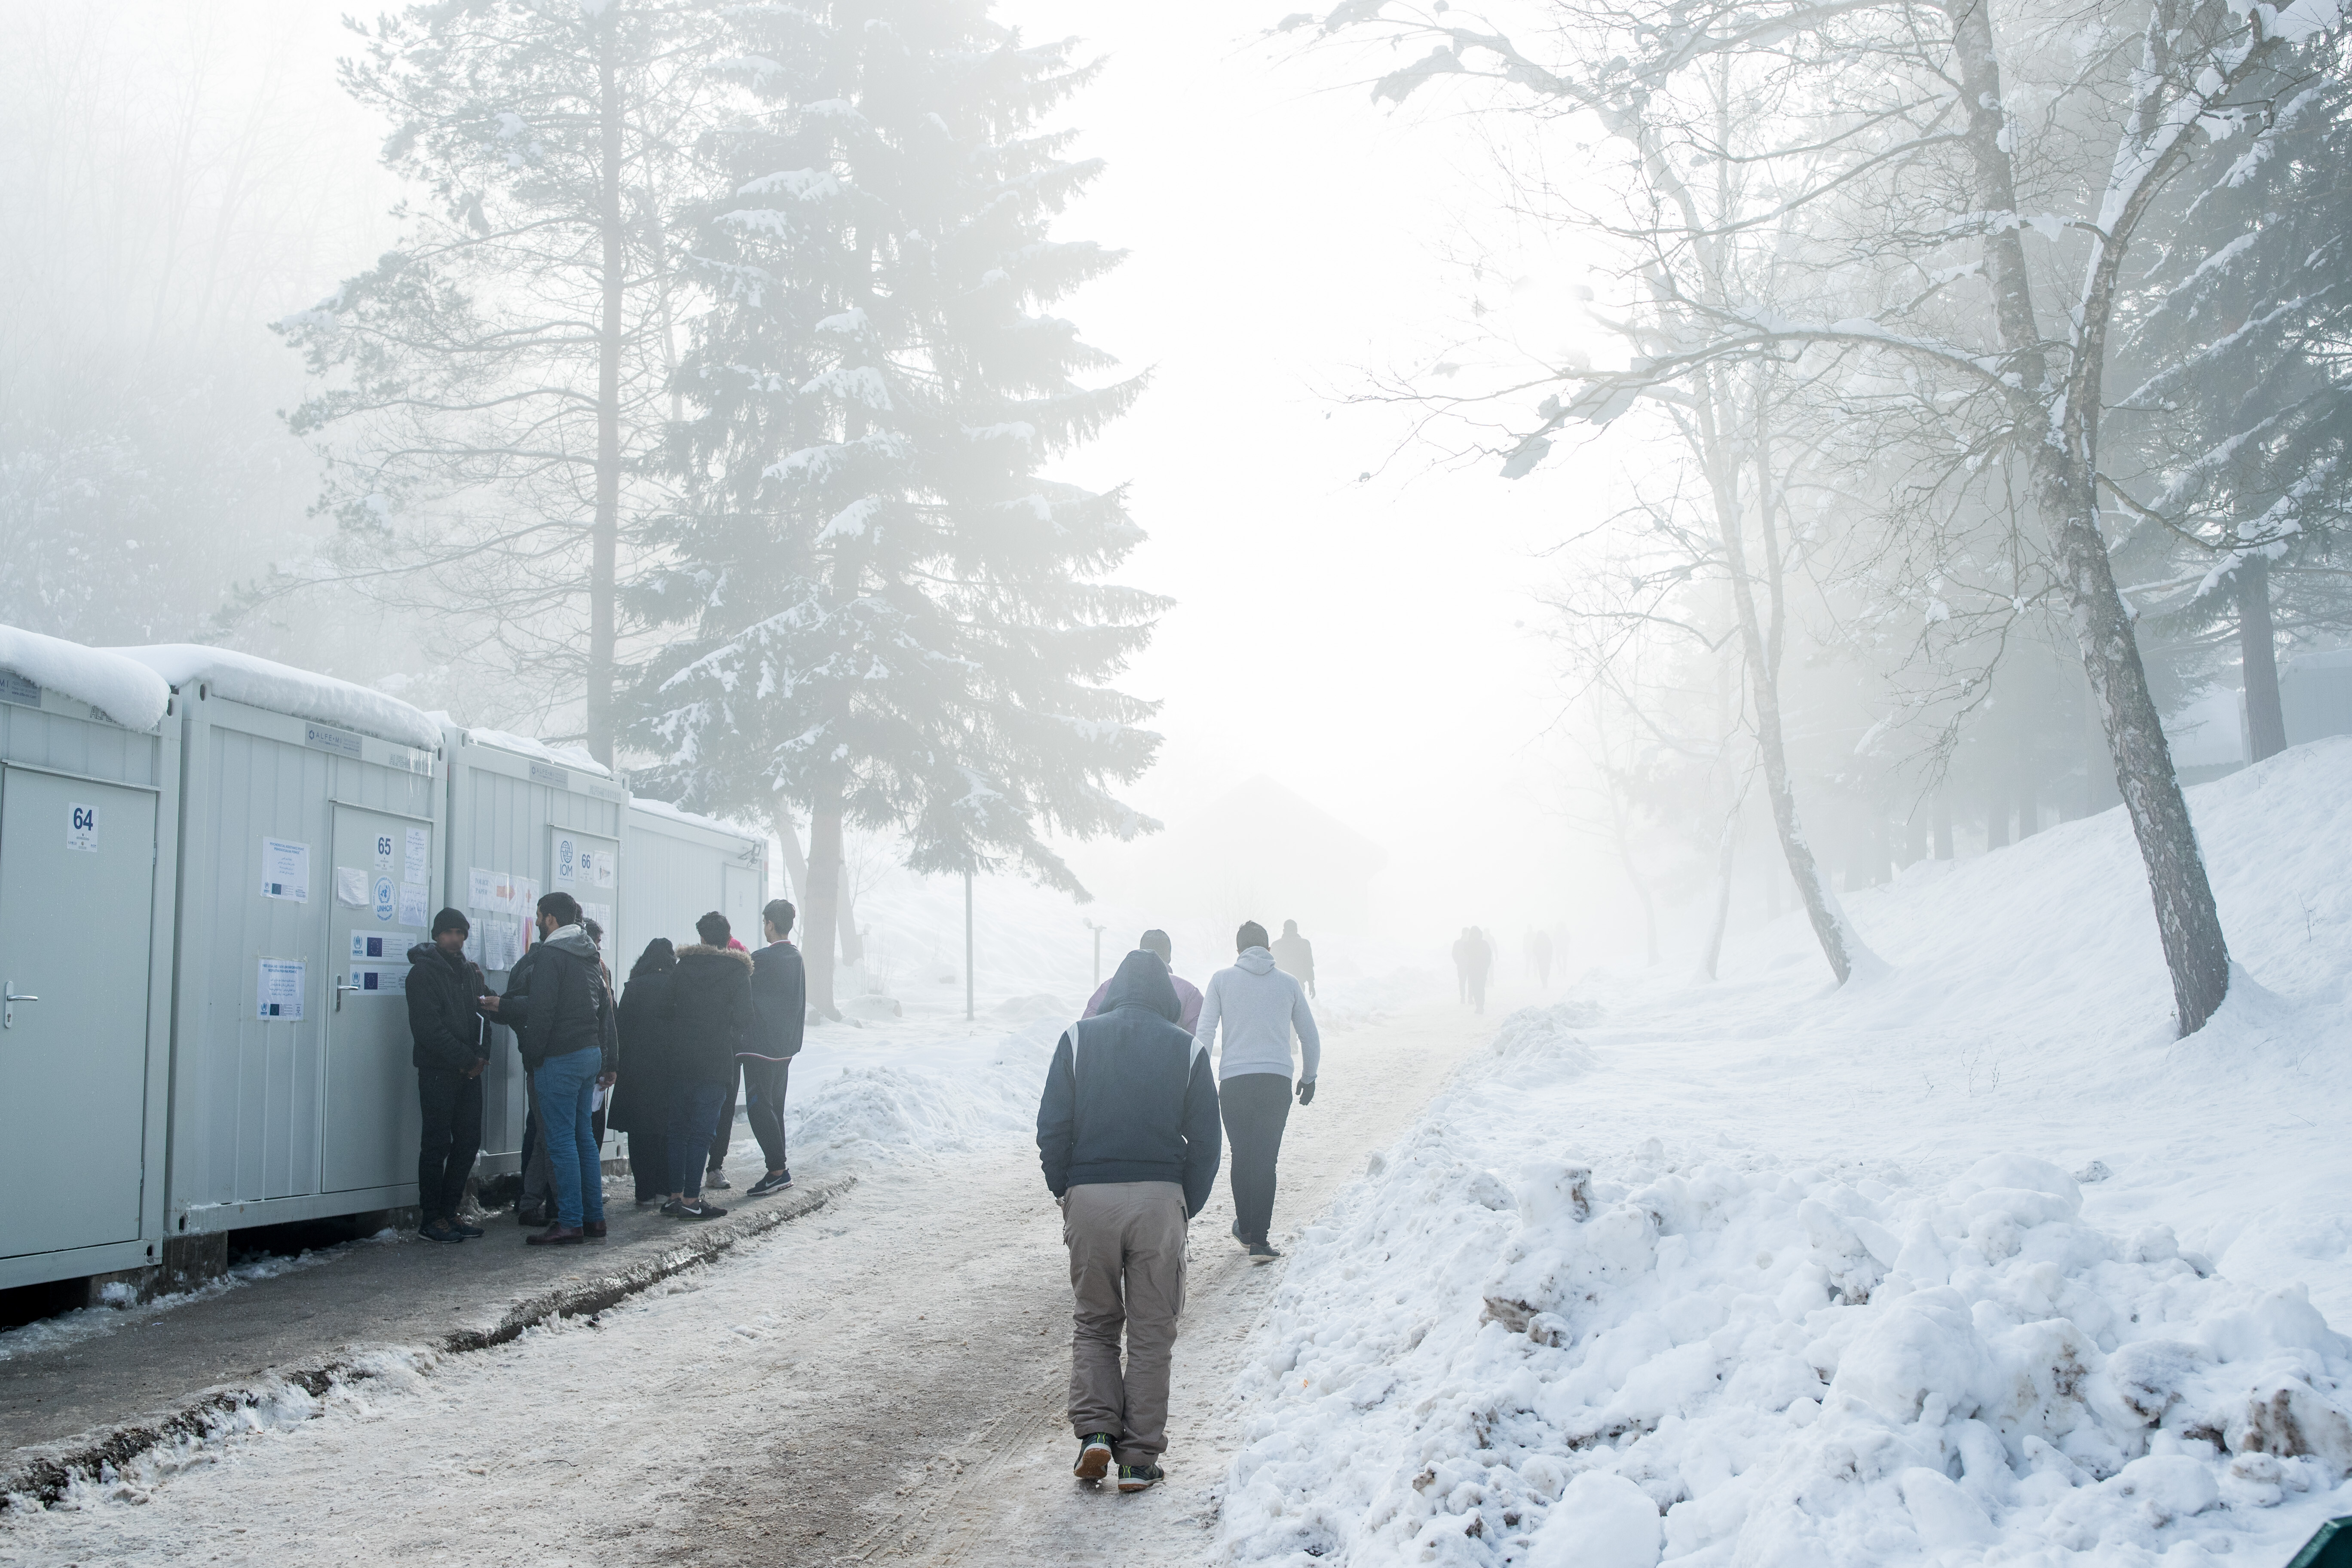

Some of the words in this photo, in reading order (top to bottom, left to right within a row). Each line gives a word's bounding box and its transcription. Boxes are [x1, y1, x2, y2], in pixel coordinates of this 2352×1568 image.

[74, 807, 93, 831] 64
[378, 836, 391, 855] 65
[582, 854, 591, 869] 66
[560, 864, 573, 877] IOM
